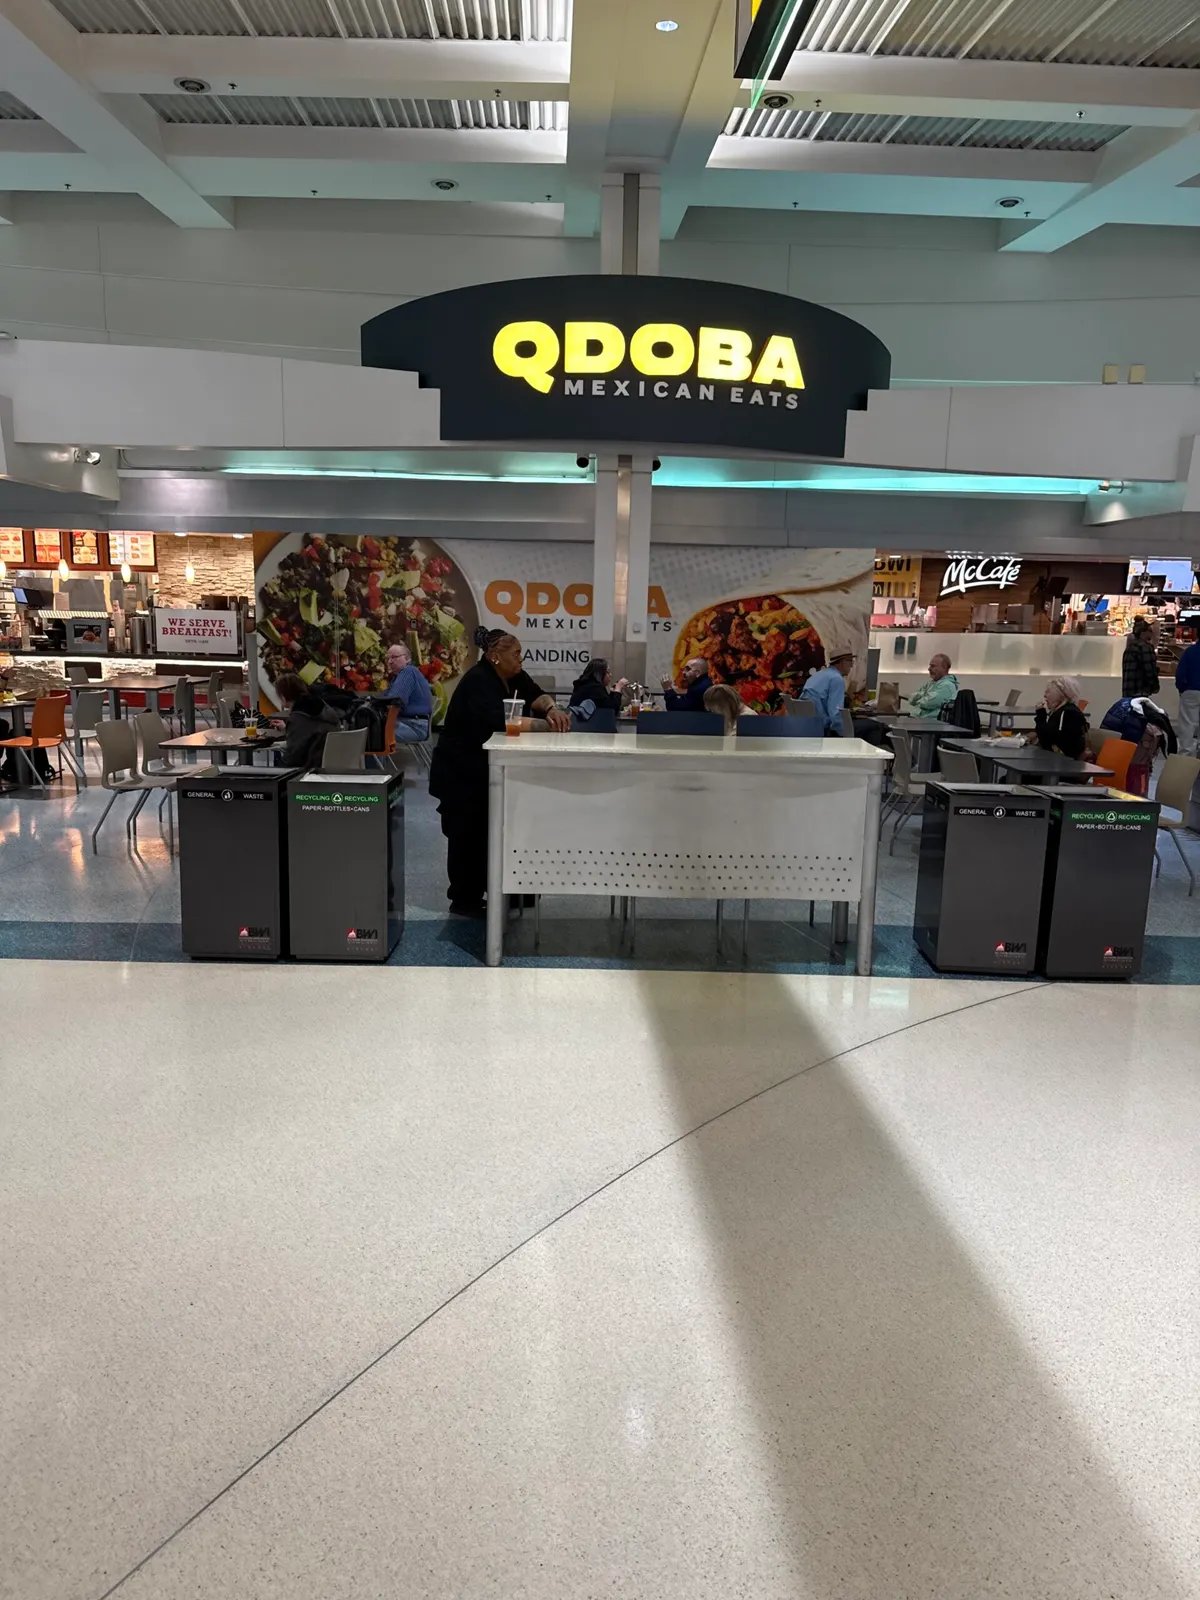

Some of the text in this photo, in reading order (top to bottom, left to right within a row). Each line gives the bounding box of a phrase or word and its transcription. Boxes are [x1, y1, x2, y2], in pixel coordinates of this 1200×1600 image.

[492, 320, 806, 394] QDOBA
[564, 379, 799, 410] MEXICAN EATS
[941, 558, 1023, 593] McCafé
[484, 579, 673, 627] QDOA
[162, 627, 232, 637] BREAKFAST!
[168, 618, 226, 628] WE SERVE
[526, 617, 588, 630] MEXIC
[523, 649, 590, 663] ANDING
